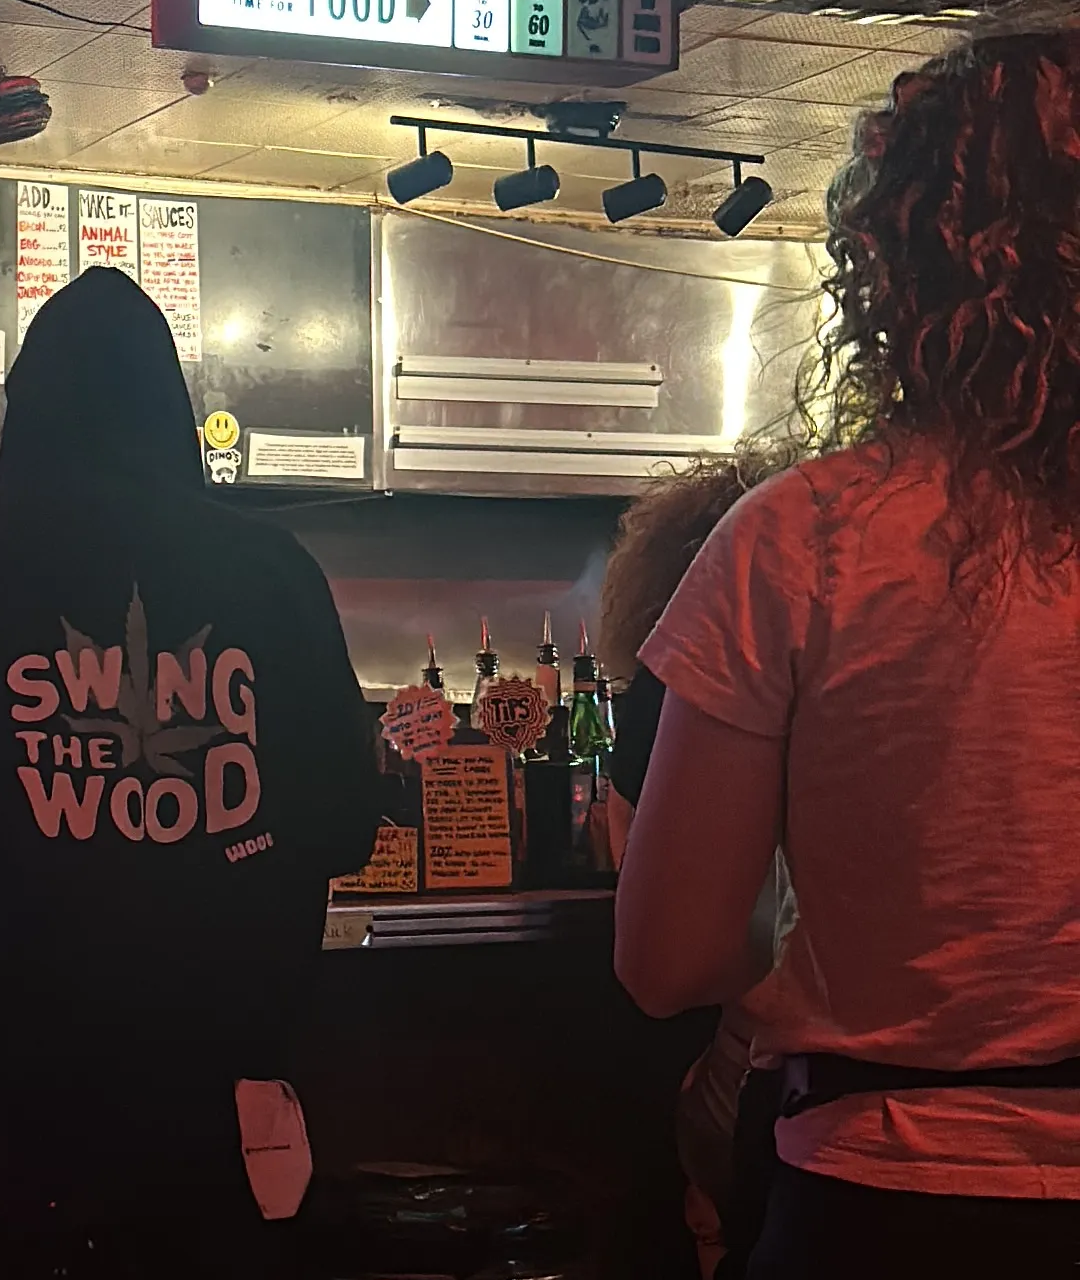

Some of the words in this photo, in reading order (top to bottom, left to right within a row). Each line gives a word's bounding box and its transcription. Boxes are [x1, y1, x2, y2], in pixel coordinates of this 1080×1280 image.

[270, 1, 293, 12] FOR
[472, 10, 493, 29] 30
[528, 15, 549, 36] 60
[79, 194, 116, 220] MAKE
[142, 203, 194, 230] SAUCES
[81, 225, 133, 243] ANIMAL
[88, 245, 127, 263] STYLE
[209, 451, 240, 463] DINO'S
[15, 731, 116, 769] THE
[17, 742, 261, 844] WOOD
